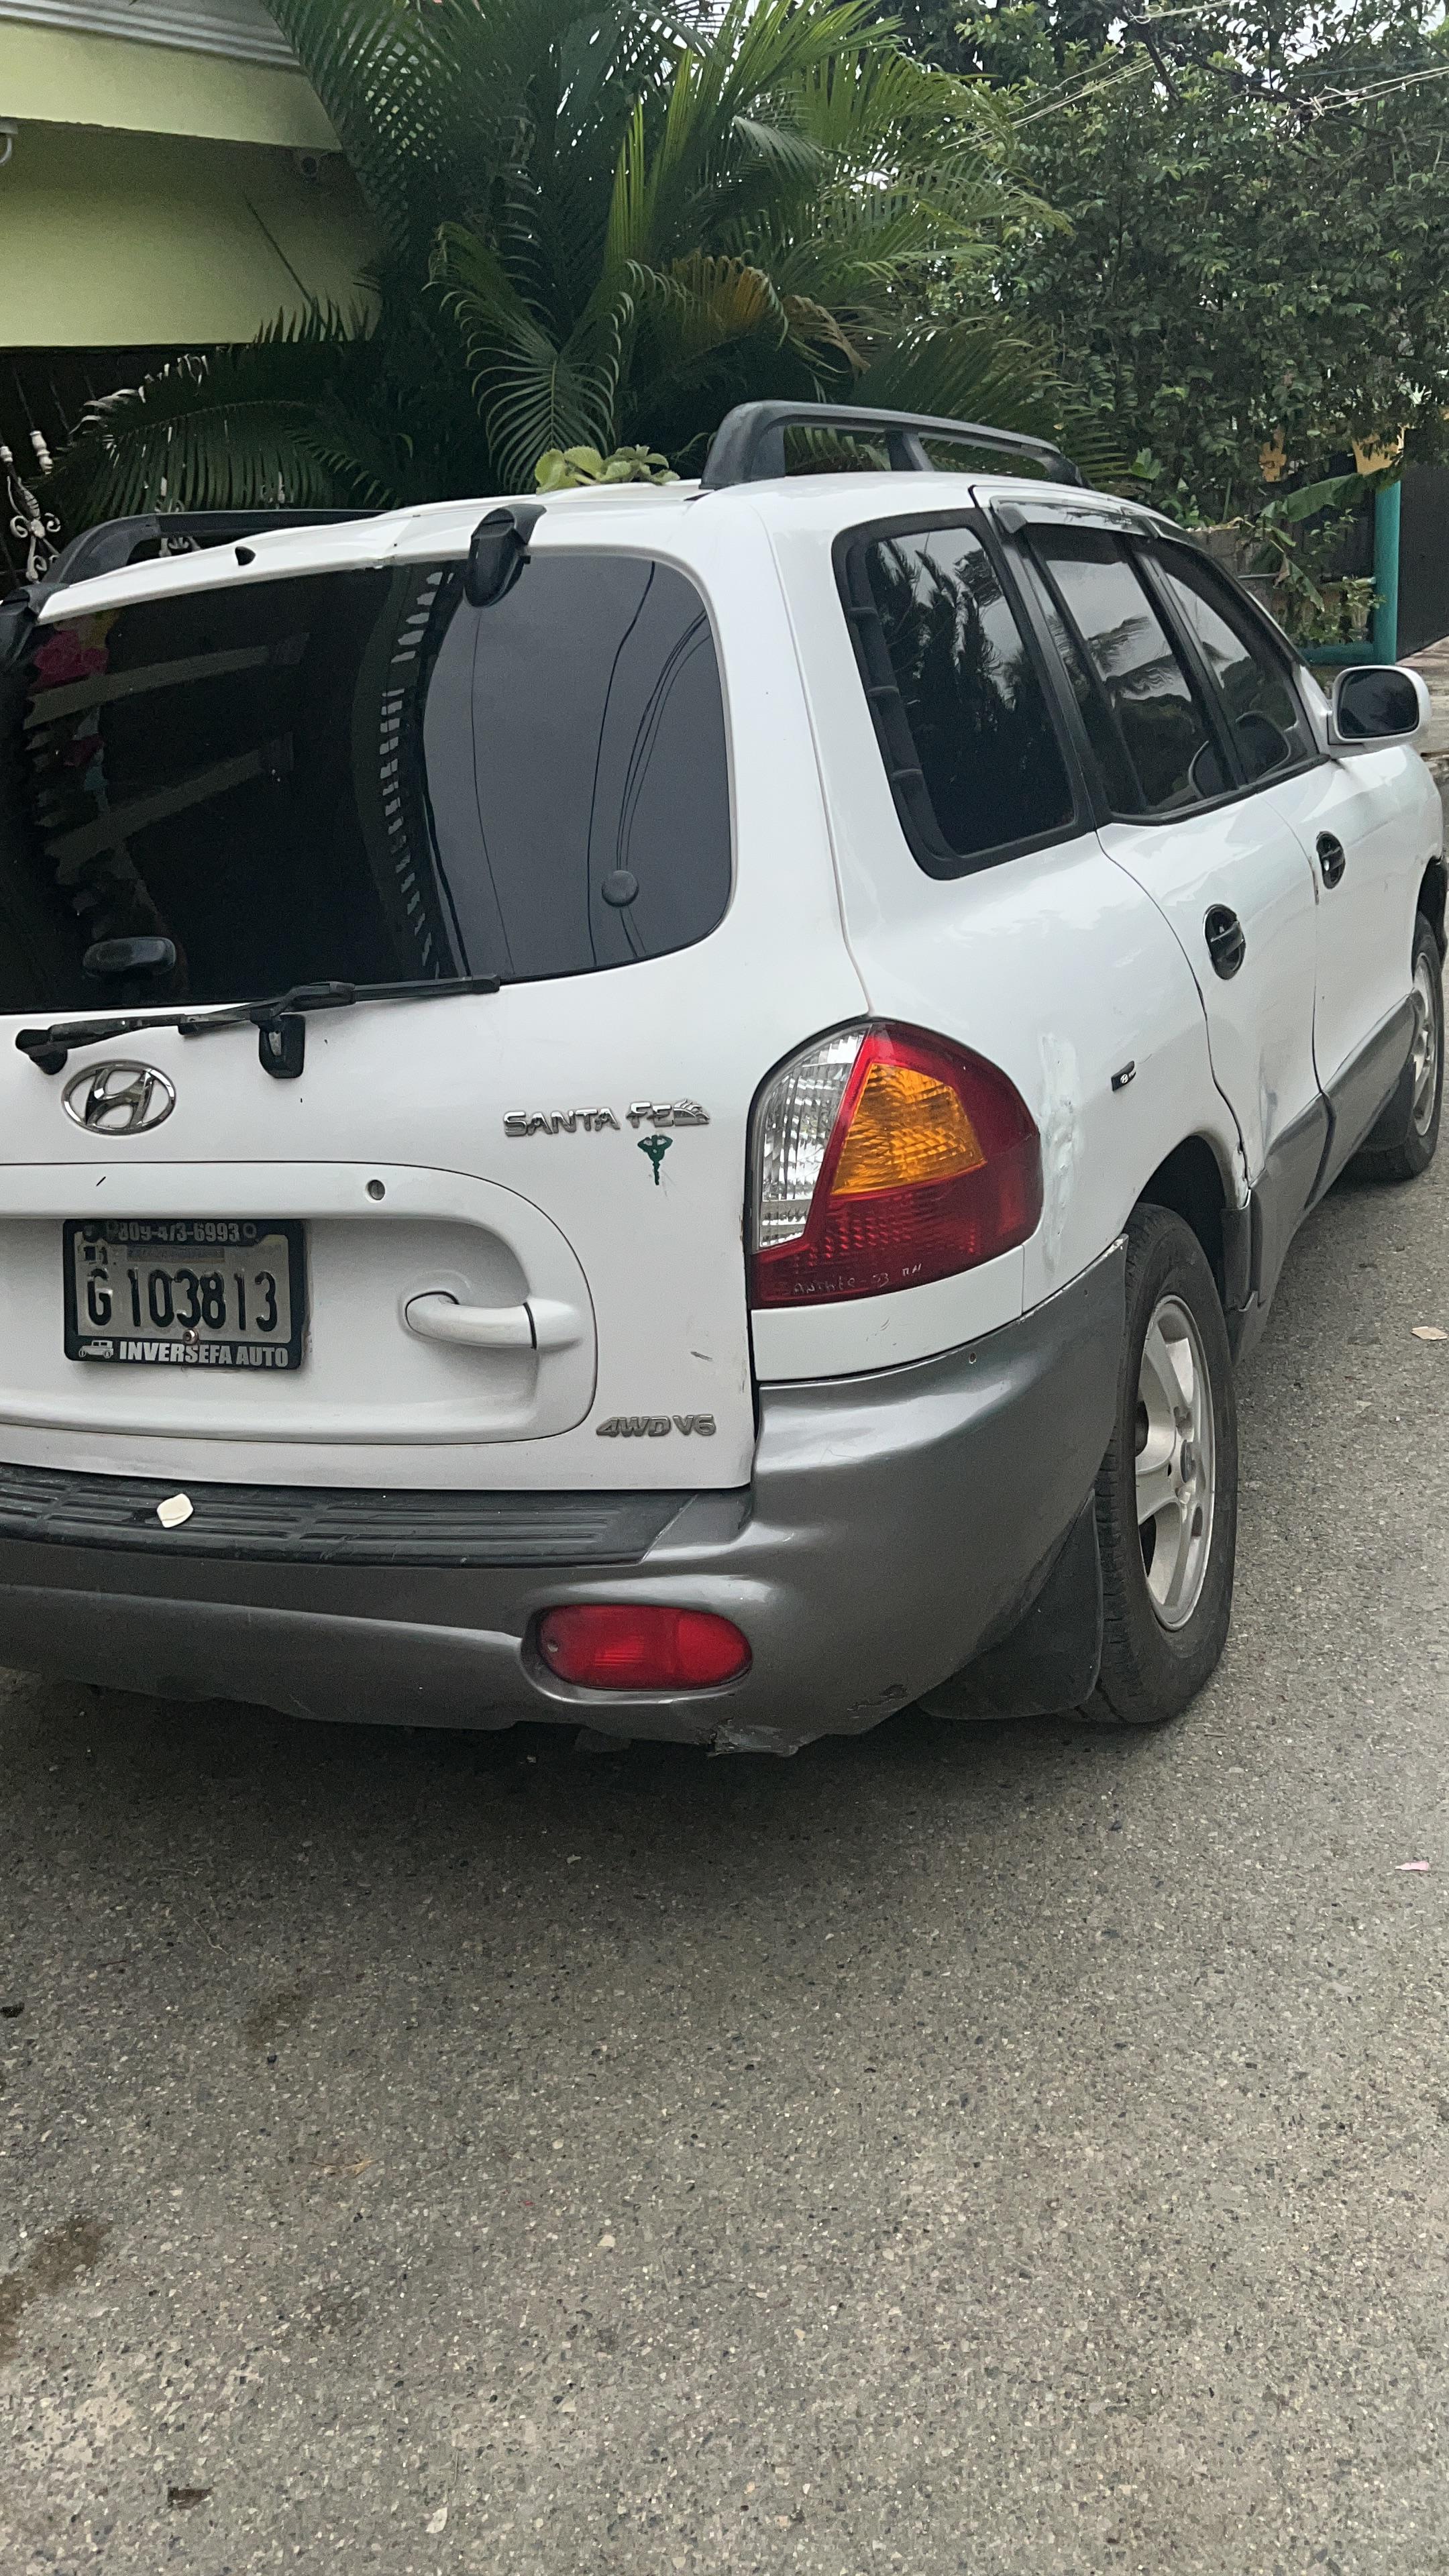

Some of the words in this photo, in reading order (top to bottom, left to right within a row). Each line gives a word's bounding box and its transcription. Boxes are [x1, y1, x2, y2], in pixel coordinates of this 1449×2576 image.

[503, 1108, 621, 1136] SANTA
[626, 1101, 674, 1128] FE
[119, 1341, 232, 1364] INVERSEFA
[237, 1345, 288, 1366] AUTO
[596, 1416, 672, 1438] 4WD
[672, 1414, 716, 1436] V6
